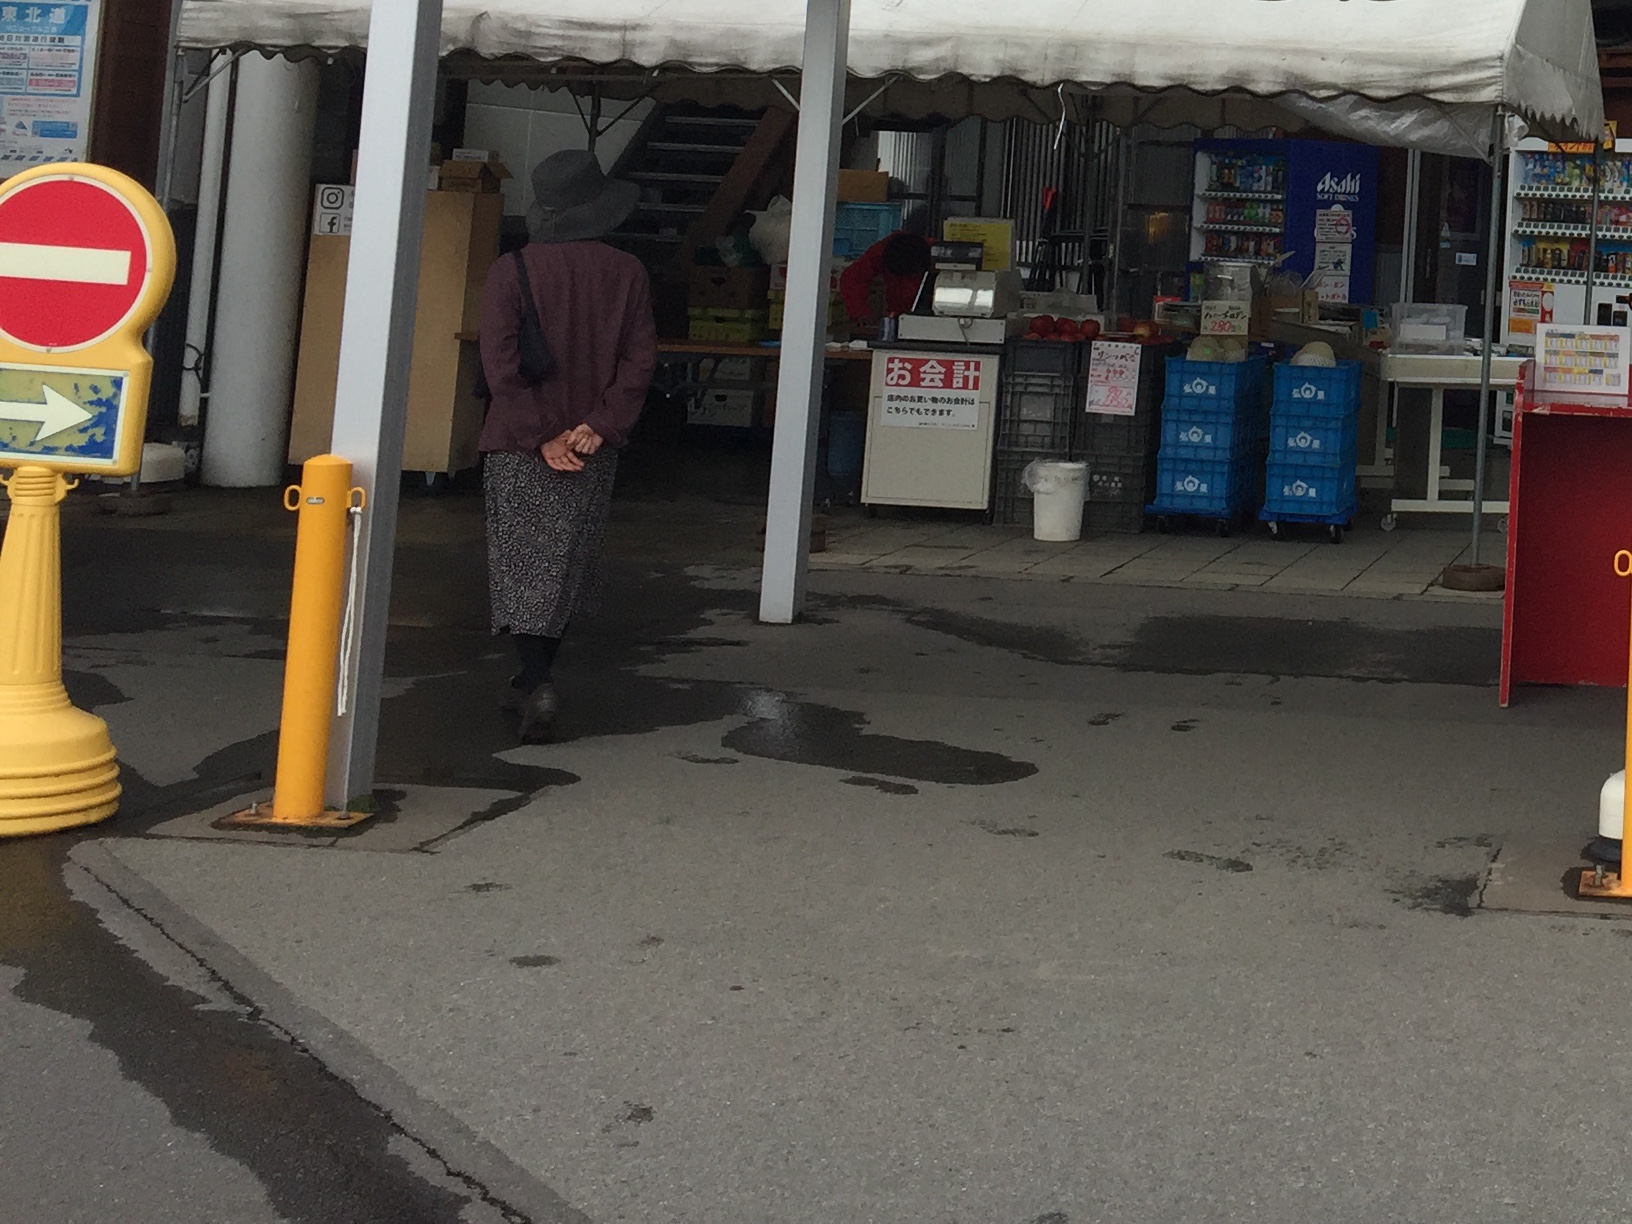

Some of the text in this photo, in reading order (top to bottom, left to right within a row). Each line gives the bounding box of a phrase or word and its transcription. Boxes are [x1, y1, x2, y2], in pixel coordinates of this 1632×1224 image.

[1317, 171, 1361, 194] Asahi
[886, 359, 980, 390] お会計
